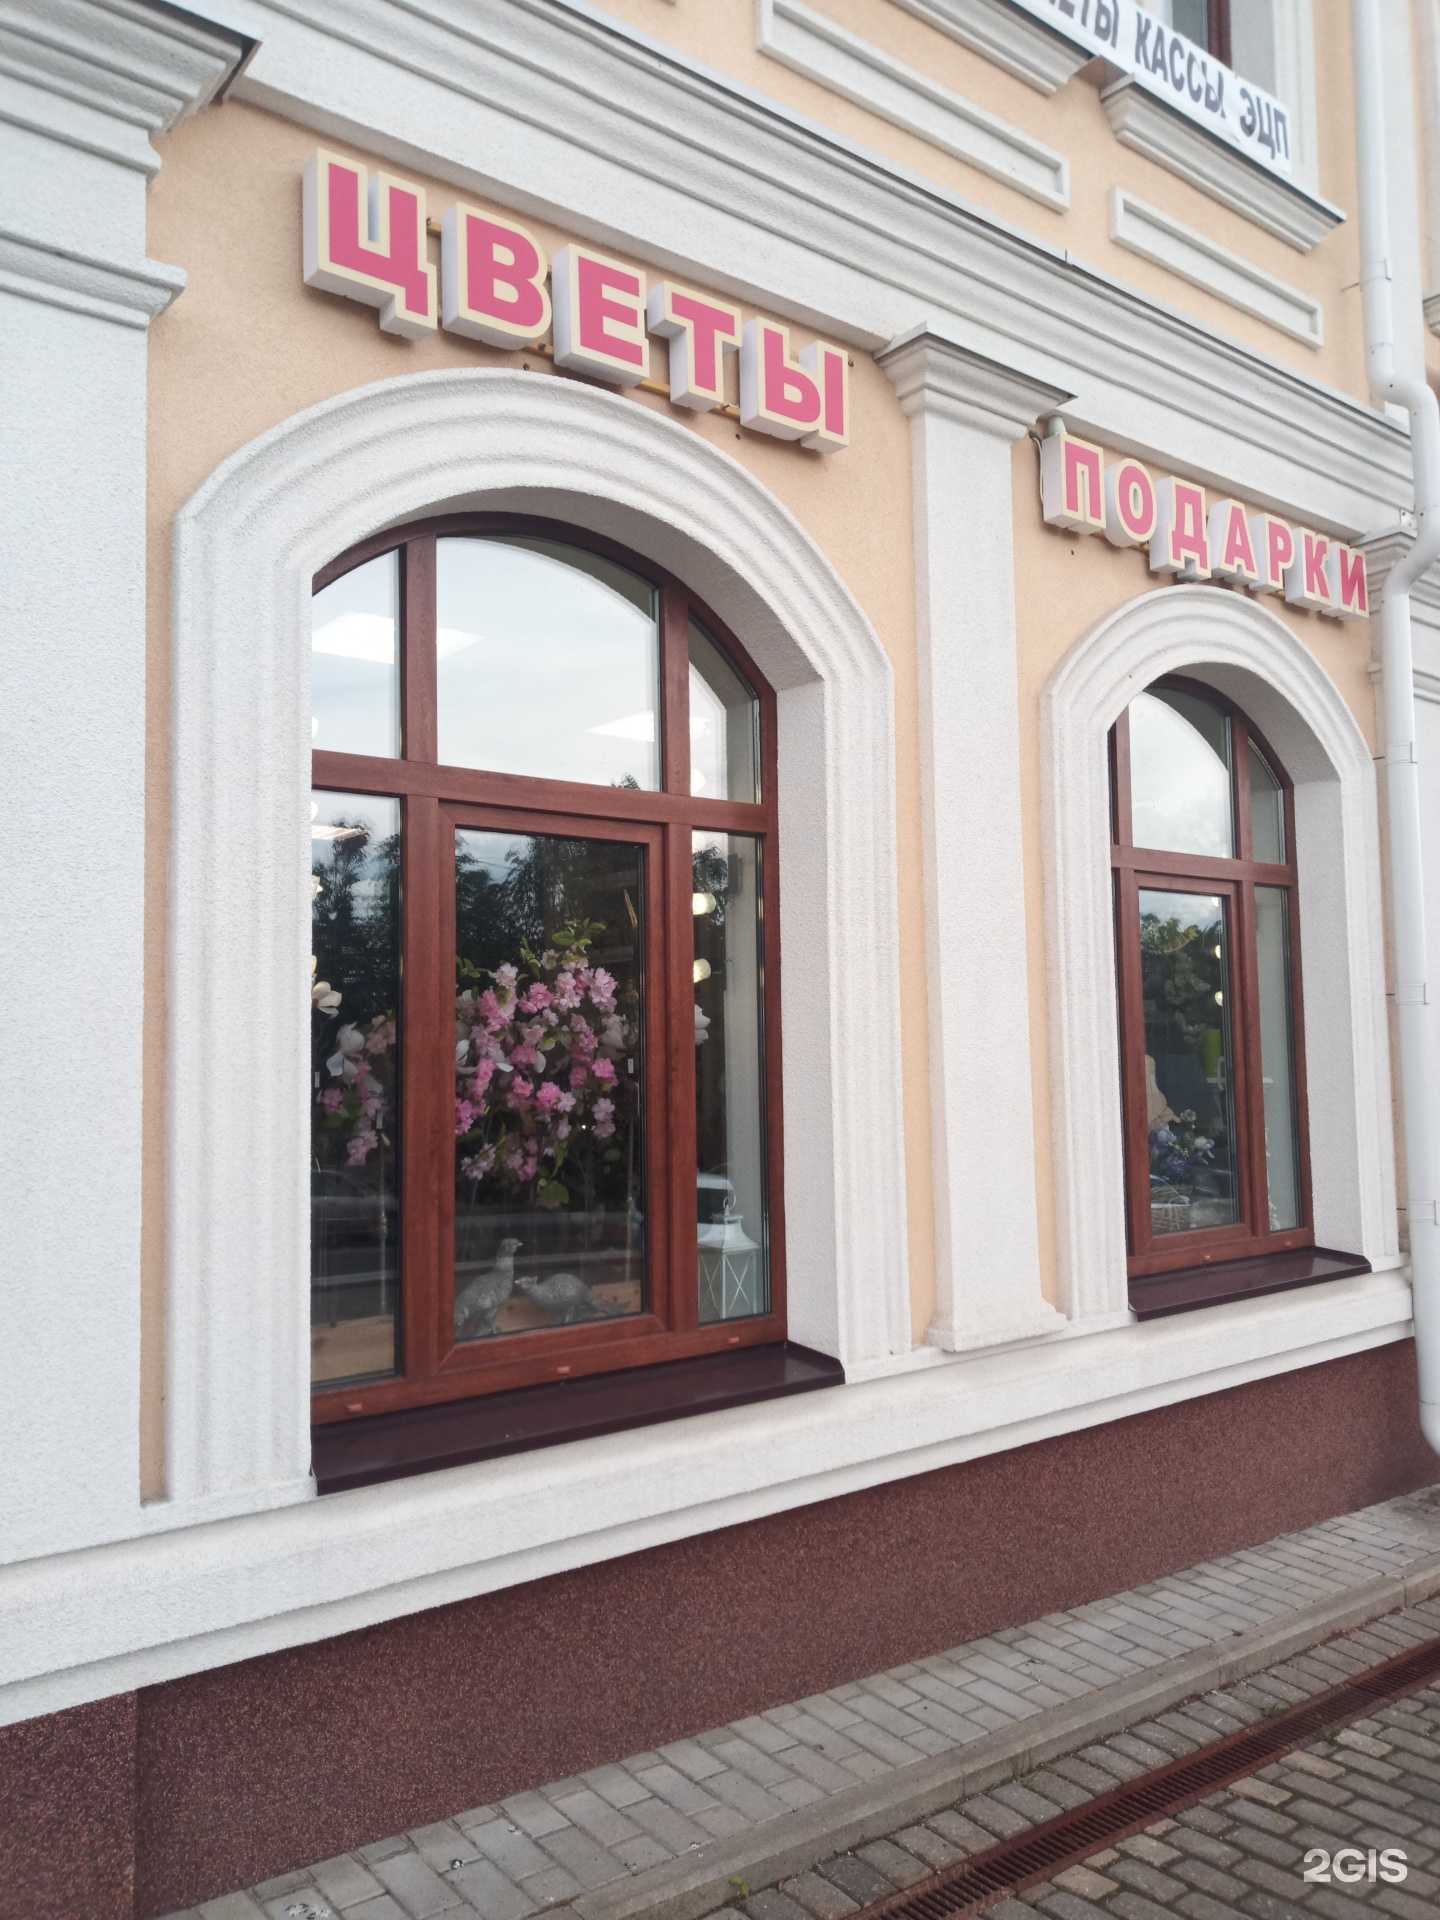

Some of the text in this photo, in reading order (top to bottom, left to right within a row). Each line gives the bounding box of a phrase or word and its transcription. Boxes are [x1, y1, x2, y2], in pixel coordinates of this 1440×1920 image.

[1135, 11, 1226, 119] КАССЫ
[1239, 87, 1289, 160] ЭЦП
[318, 152, 848, 444] ЦВЕТЫ
[1061, 434, 1368, 616] ПОДАРКИ
